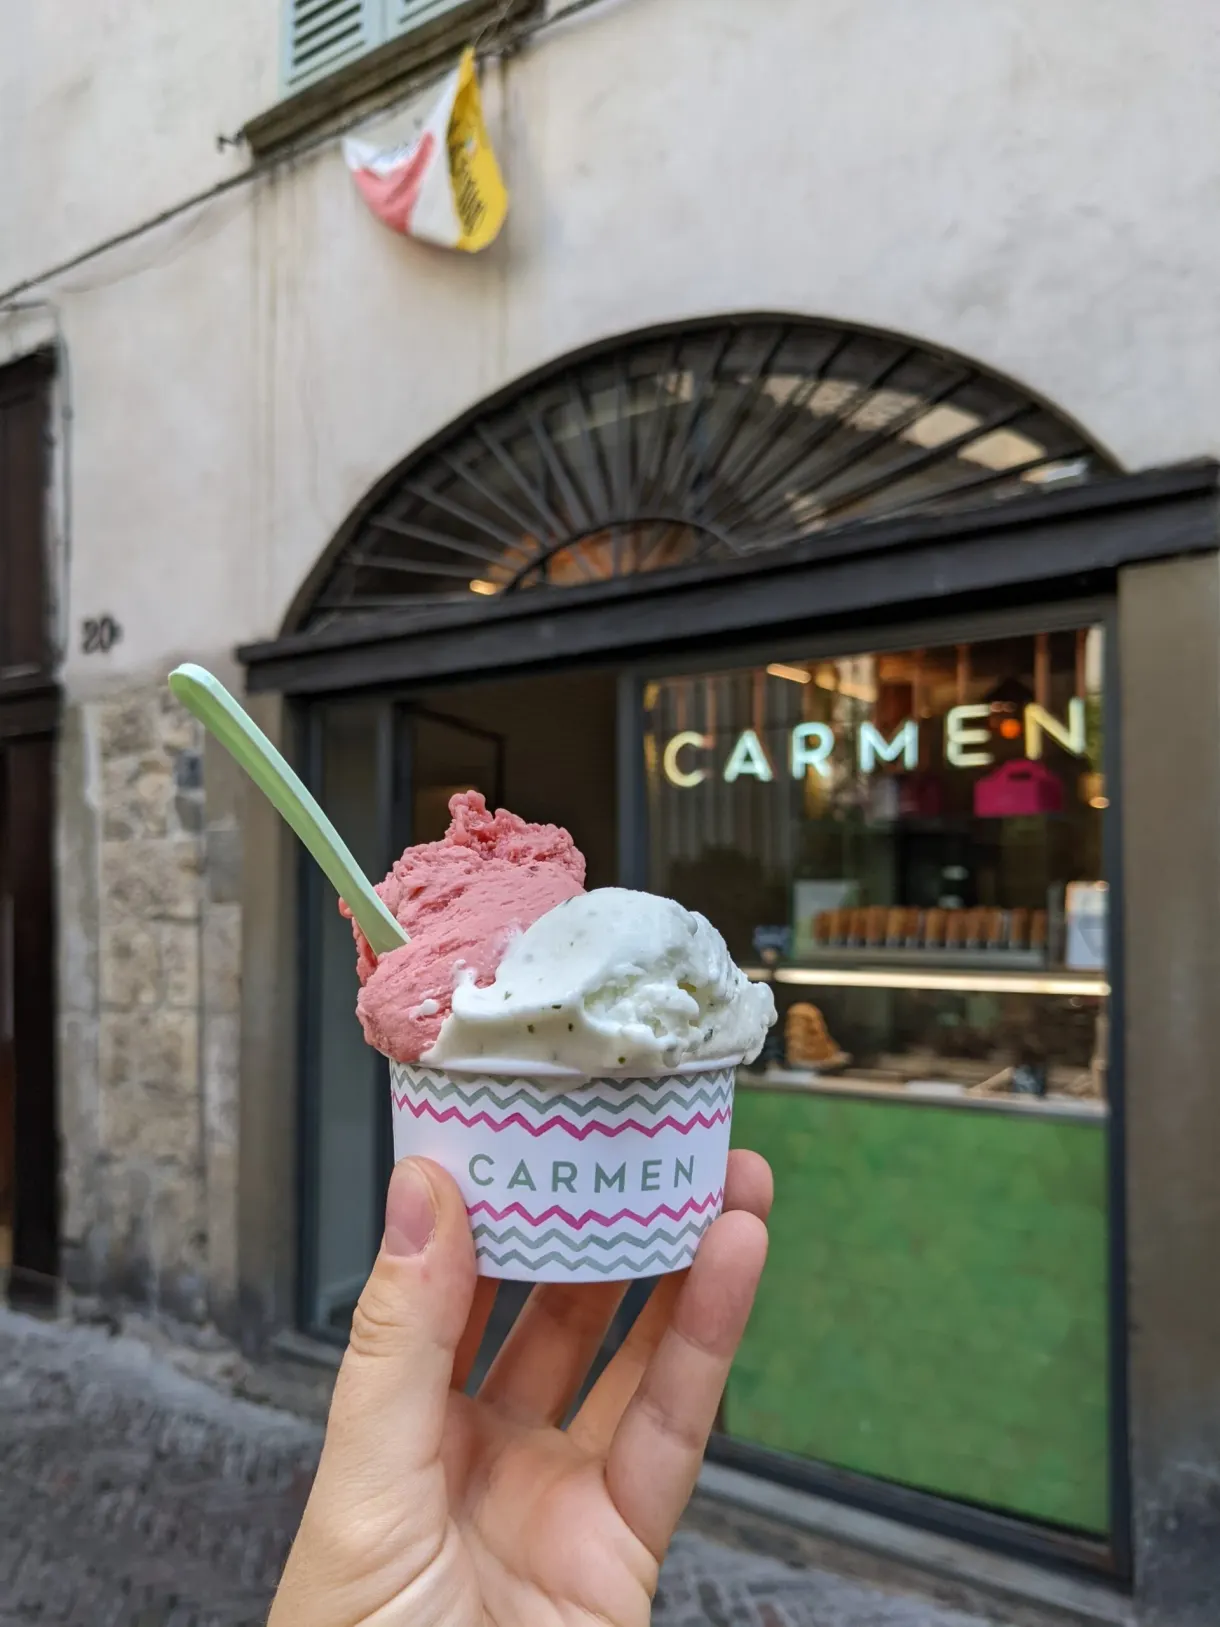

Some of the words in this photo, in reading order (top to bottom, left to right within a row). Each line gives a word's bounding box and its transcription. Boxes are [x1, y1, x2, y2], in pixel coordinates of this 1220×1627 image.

[82, 616, 121, 653] 20
[663, 697, 1087, 788] CARMEN
[468, 1153, 695, 1194] CARMEN
